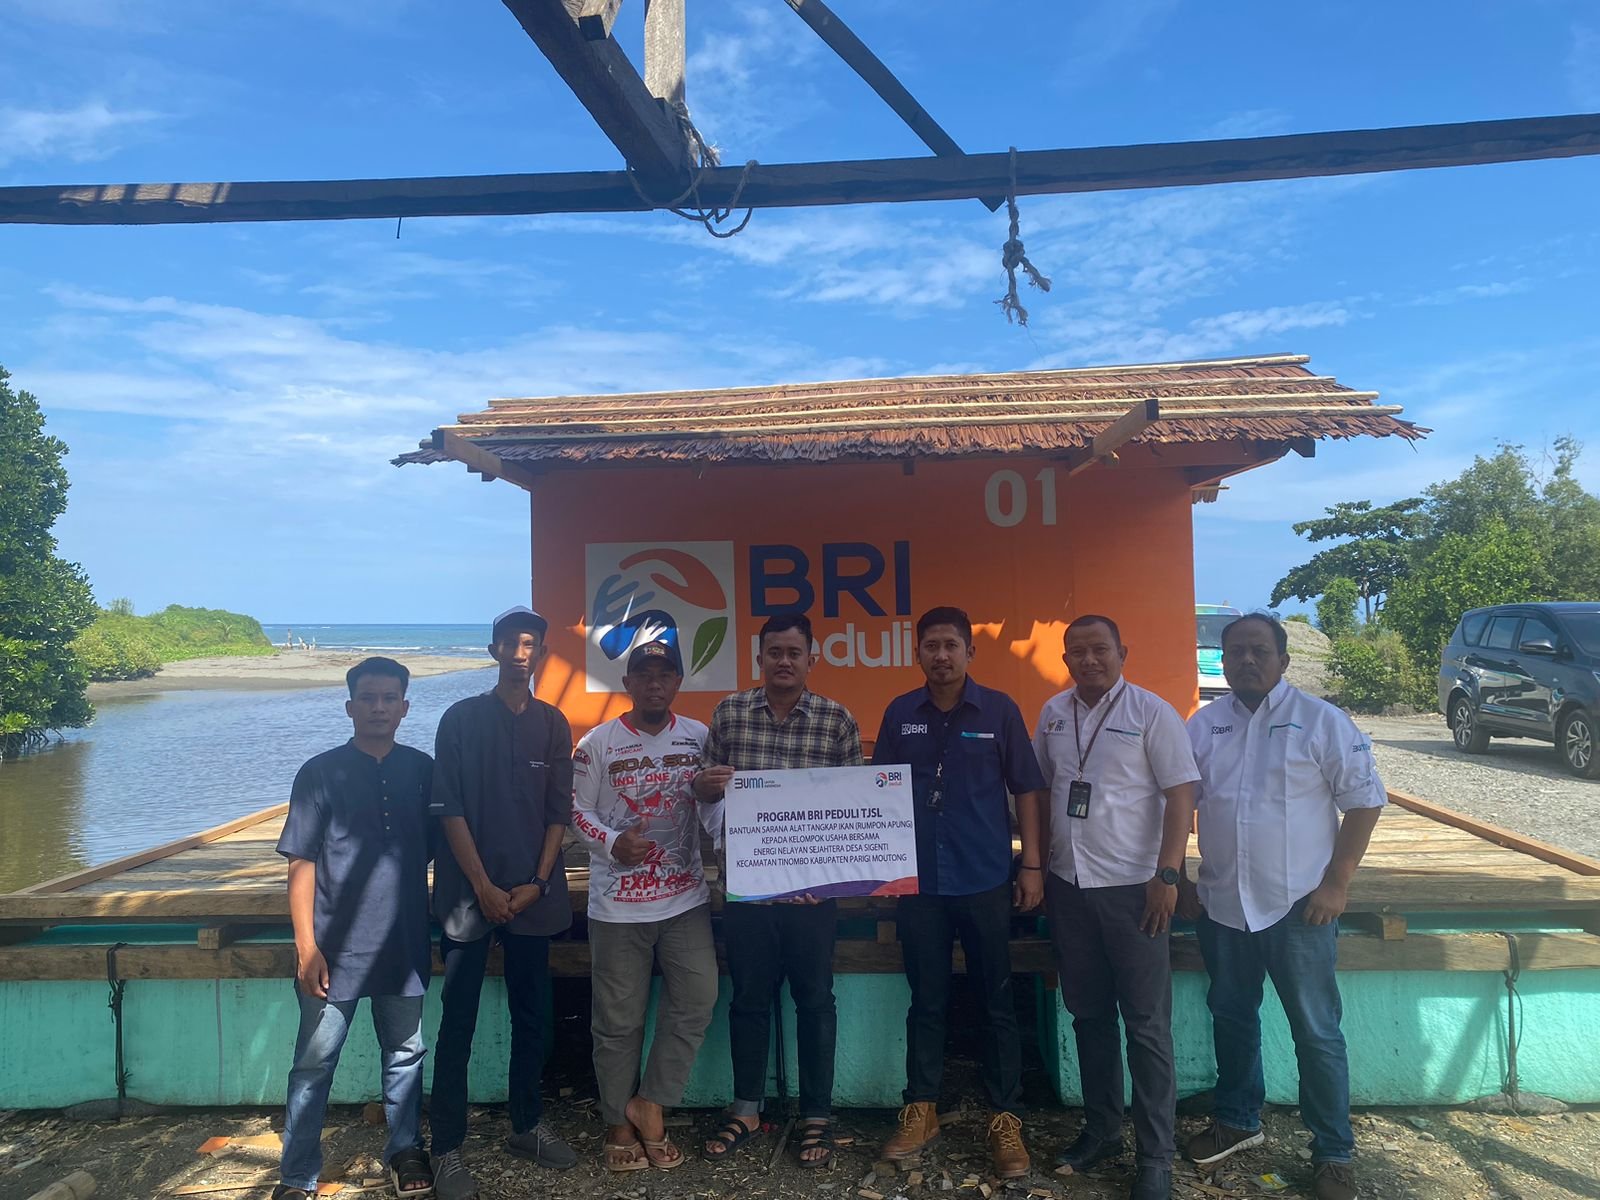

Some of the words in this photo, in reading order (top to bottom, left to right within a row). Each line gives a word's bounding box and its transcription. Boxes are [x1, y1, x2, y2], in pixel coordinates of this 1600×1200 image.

[985, 468, 1056, 527] 01
[749, 541, 911, 617] BRI
[752, 622, 912, 680] duli
[911, 723, 928, 734] BRI
[888, 772, 902, 781] BRI
[757, 810, 806, 823] PROGRAM
[807, 809, 823, 820] BRI
[825, 808, 859, 820] PEDULI
[861, 807, 883, 818] TJSL
[729, 826, 761, 835] BANTUAN
[761, 825, 788, 834] SARANA
[789, 823, 807, 832] ALAT
[806, 822, 838, 832] TANGKAP
[838, 822, 854, 831] IKAN
[855, 820, 887, 830] (RUMPON
[887, 820, 913, 829] APUNG)
[761, 836, 788, 845] KEPADA
[788, 834, 825, 844] KELOMPOK
[825, 833, 849, 842] USAHA
[849, 832, 880, 841] BERSAMA
[753, 847, 777, 856] ENERGI
[777, 846, 808, 855] NELAYAN
[808, 844, 845, 854] SEJAHTERA
[845, 844, 863, 852] DESA
[864, 842, 889, 852] SIGENTI
[736, 859, 777, 868] KECAMATAN
[778, 857, 810, 866] TINOMBO
[810, 855, 849, 865] KABUPATEN
[849, 854, 871, 863] PARIGI
[872, 853, 907, 862] MOUTONG
